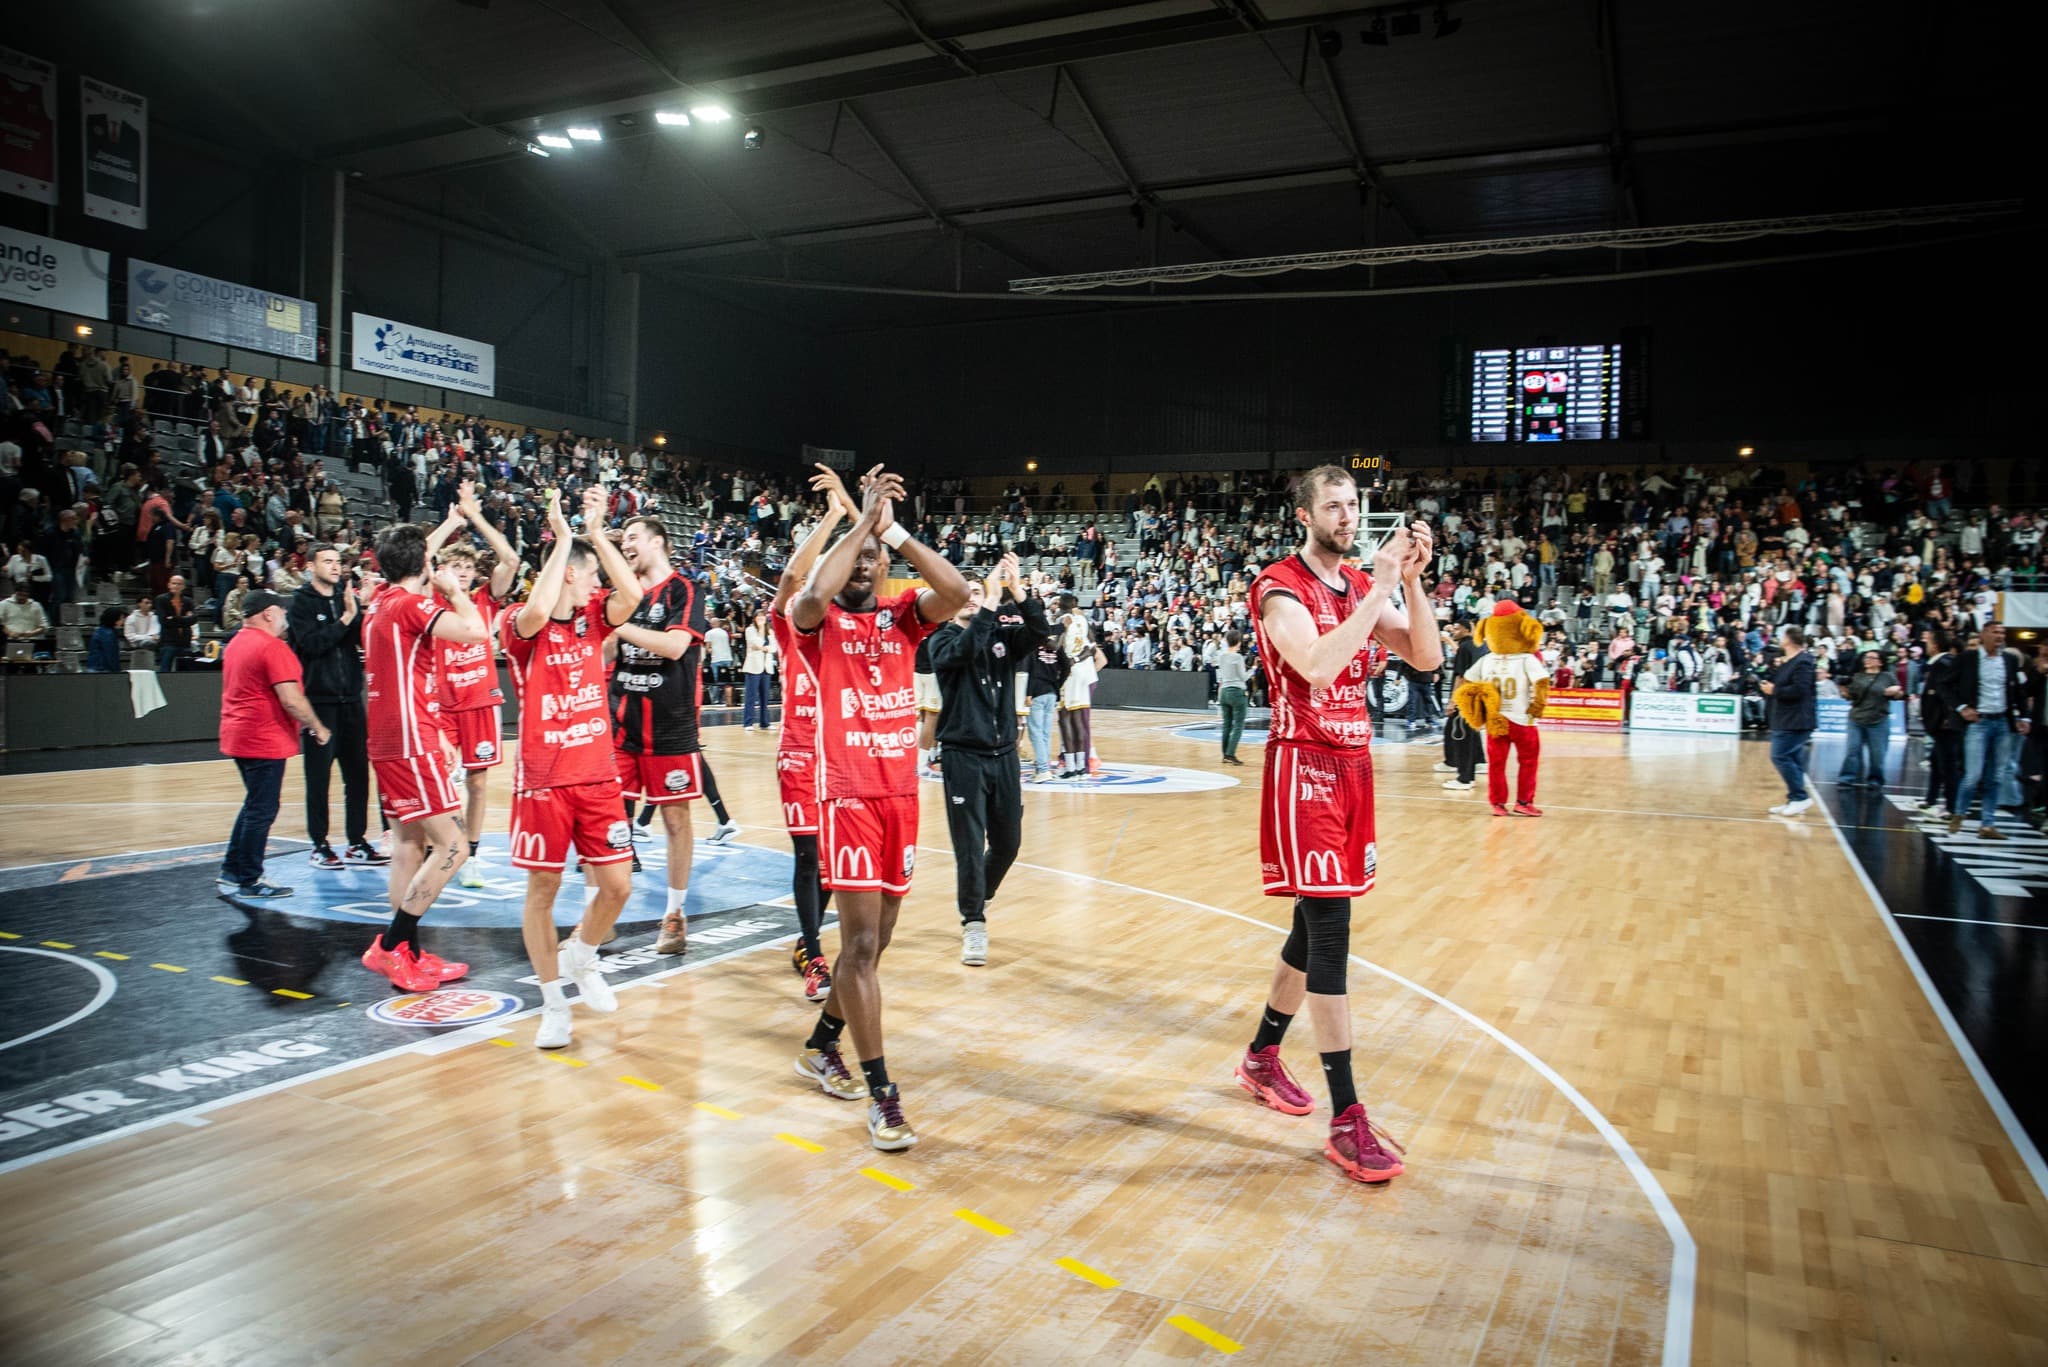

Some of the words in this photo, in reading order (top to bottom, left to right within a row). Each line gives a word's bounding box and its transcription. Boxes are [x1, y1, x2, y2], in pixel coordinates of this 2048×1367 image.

[173, 274, 285, 312] GONDRAND
[1352, 457, 1379, 469] 0:00
[868, 665, 883, 687] 3
[858, 686, 916, 711] VENDÉE
[846, 731, 899, 748] HYPER
[686, 919, 786, 945] KING
[393, 991, 459, 1019] BURGER
[414, 993, 491, 1023] KING
[133, 1038, 331, 1092] KING
